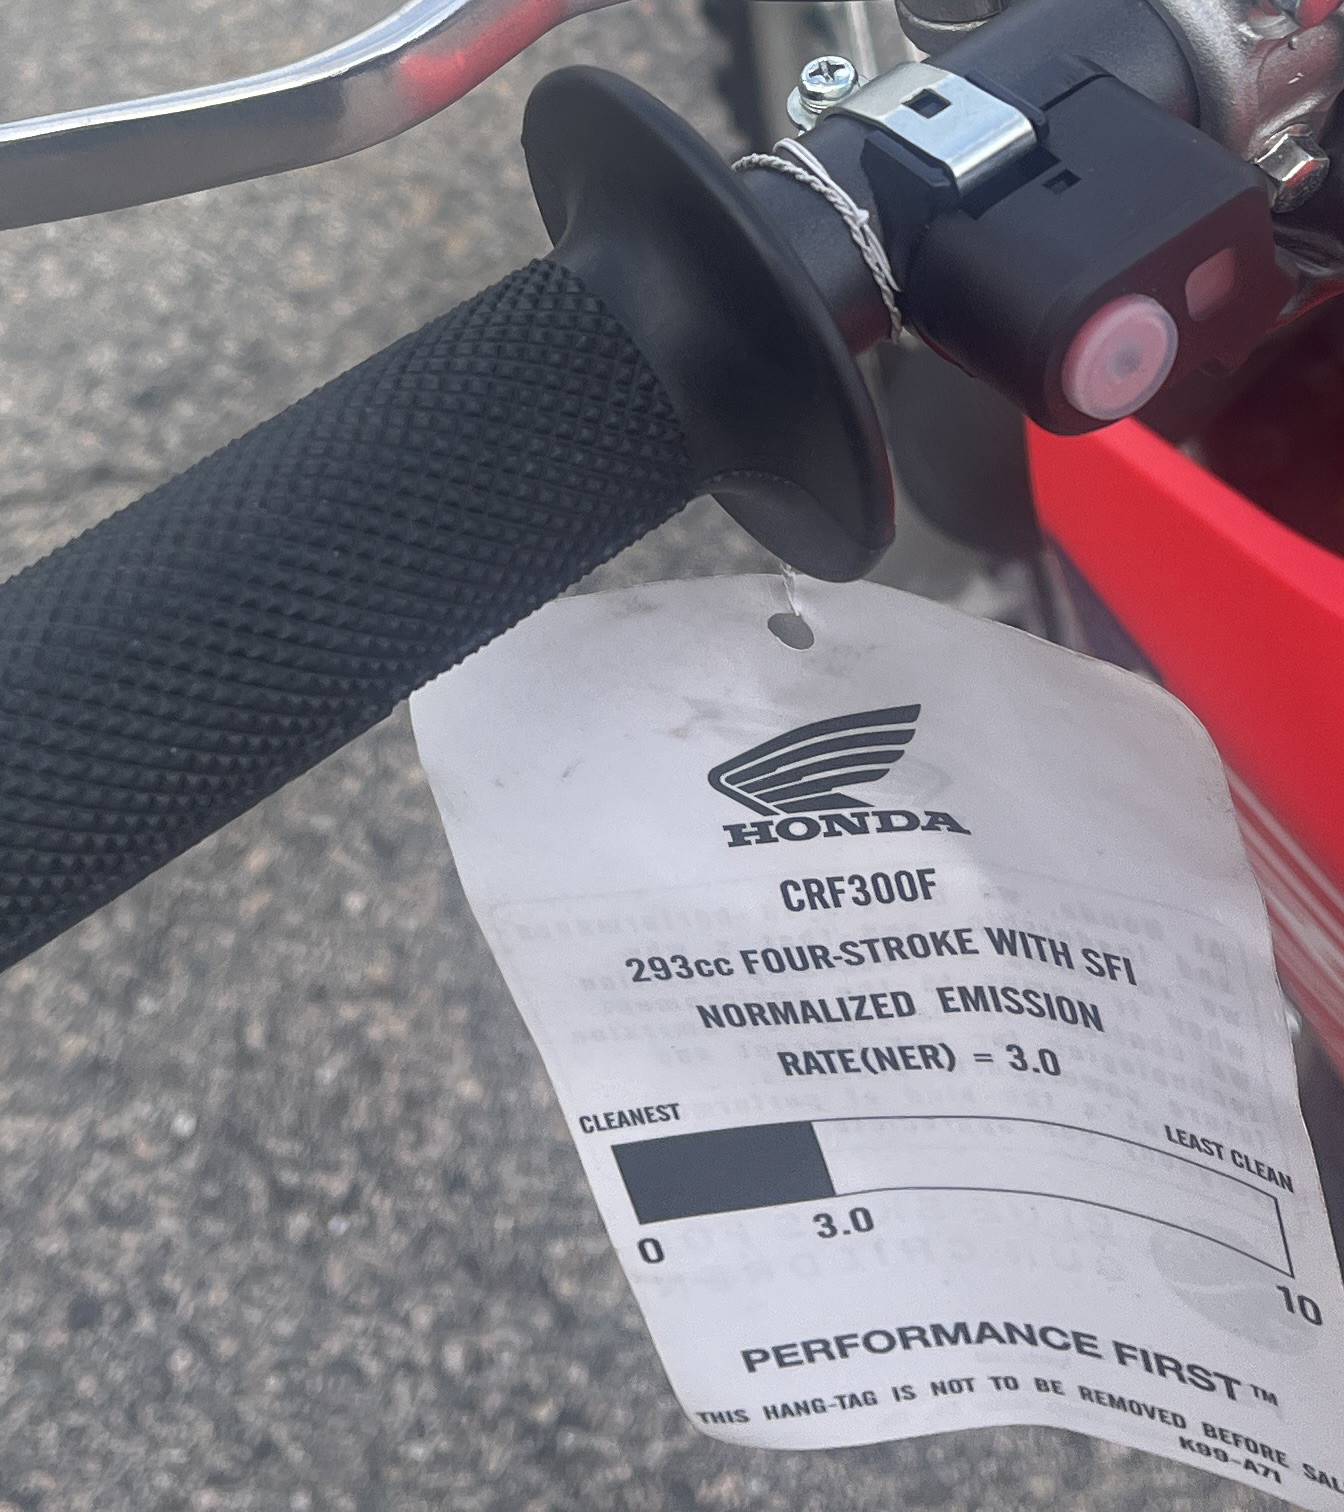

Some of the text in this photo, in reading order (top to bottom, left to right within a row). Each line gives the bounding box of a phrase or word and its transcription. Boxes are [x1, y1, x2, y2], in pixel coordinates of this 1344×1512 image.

[722, 810, 971, 847] HONDA
[780, 868, 936, 912] CRF300F
[625, 927, 1137, 986] 293cc FOUR-STROKE WITH SFI
[696, 986, 1104, 1032] NORMALIZED EMISSION
[777, 1042, 1061, 1076] RATE(NER) = 3.0
[579, 1103, 680, 1134] CLEANEST
[1164, 1125, 1294, 1193] LEAST CLEAN
[813, 1207, 874, 1238] 3.0
[637, 1238, 665, 1264] 0
[1276, 1285, 1323, 1326] 10
[741, 1321, 1103, 1373] PERFORMANCE
[697, 1409, 750, 1423] THIS
[763, 1390, 878, 1420] HANG-TAG
[892, 1385, 917, 1402] IS
[930, 1378, 974, 1396] NOT
[988, 1376, 1019, 1391] TO
[1034, 1378, 1065, 1395] BE
[1078, 1386, 1187, 1429] REMOVED
[1202, 1422, 1289, 1468] BEFORE
